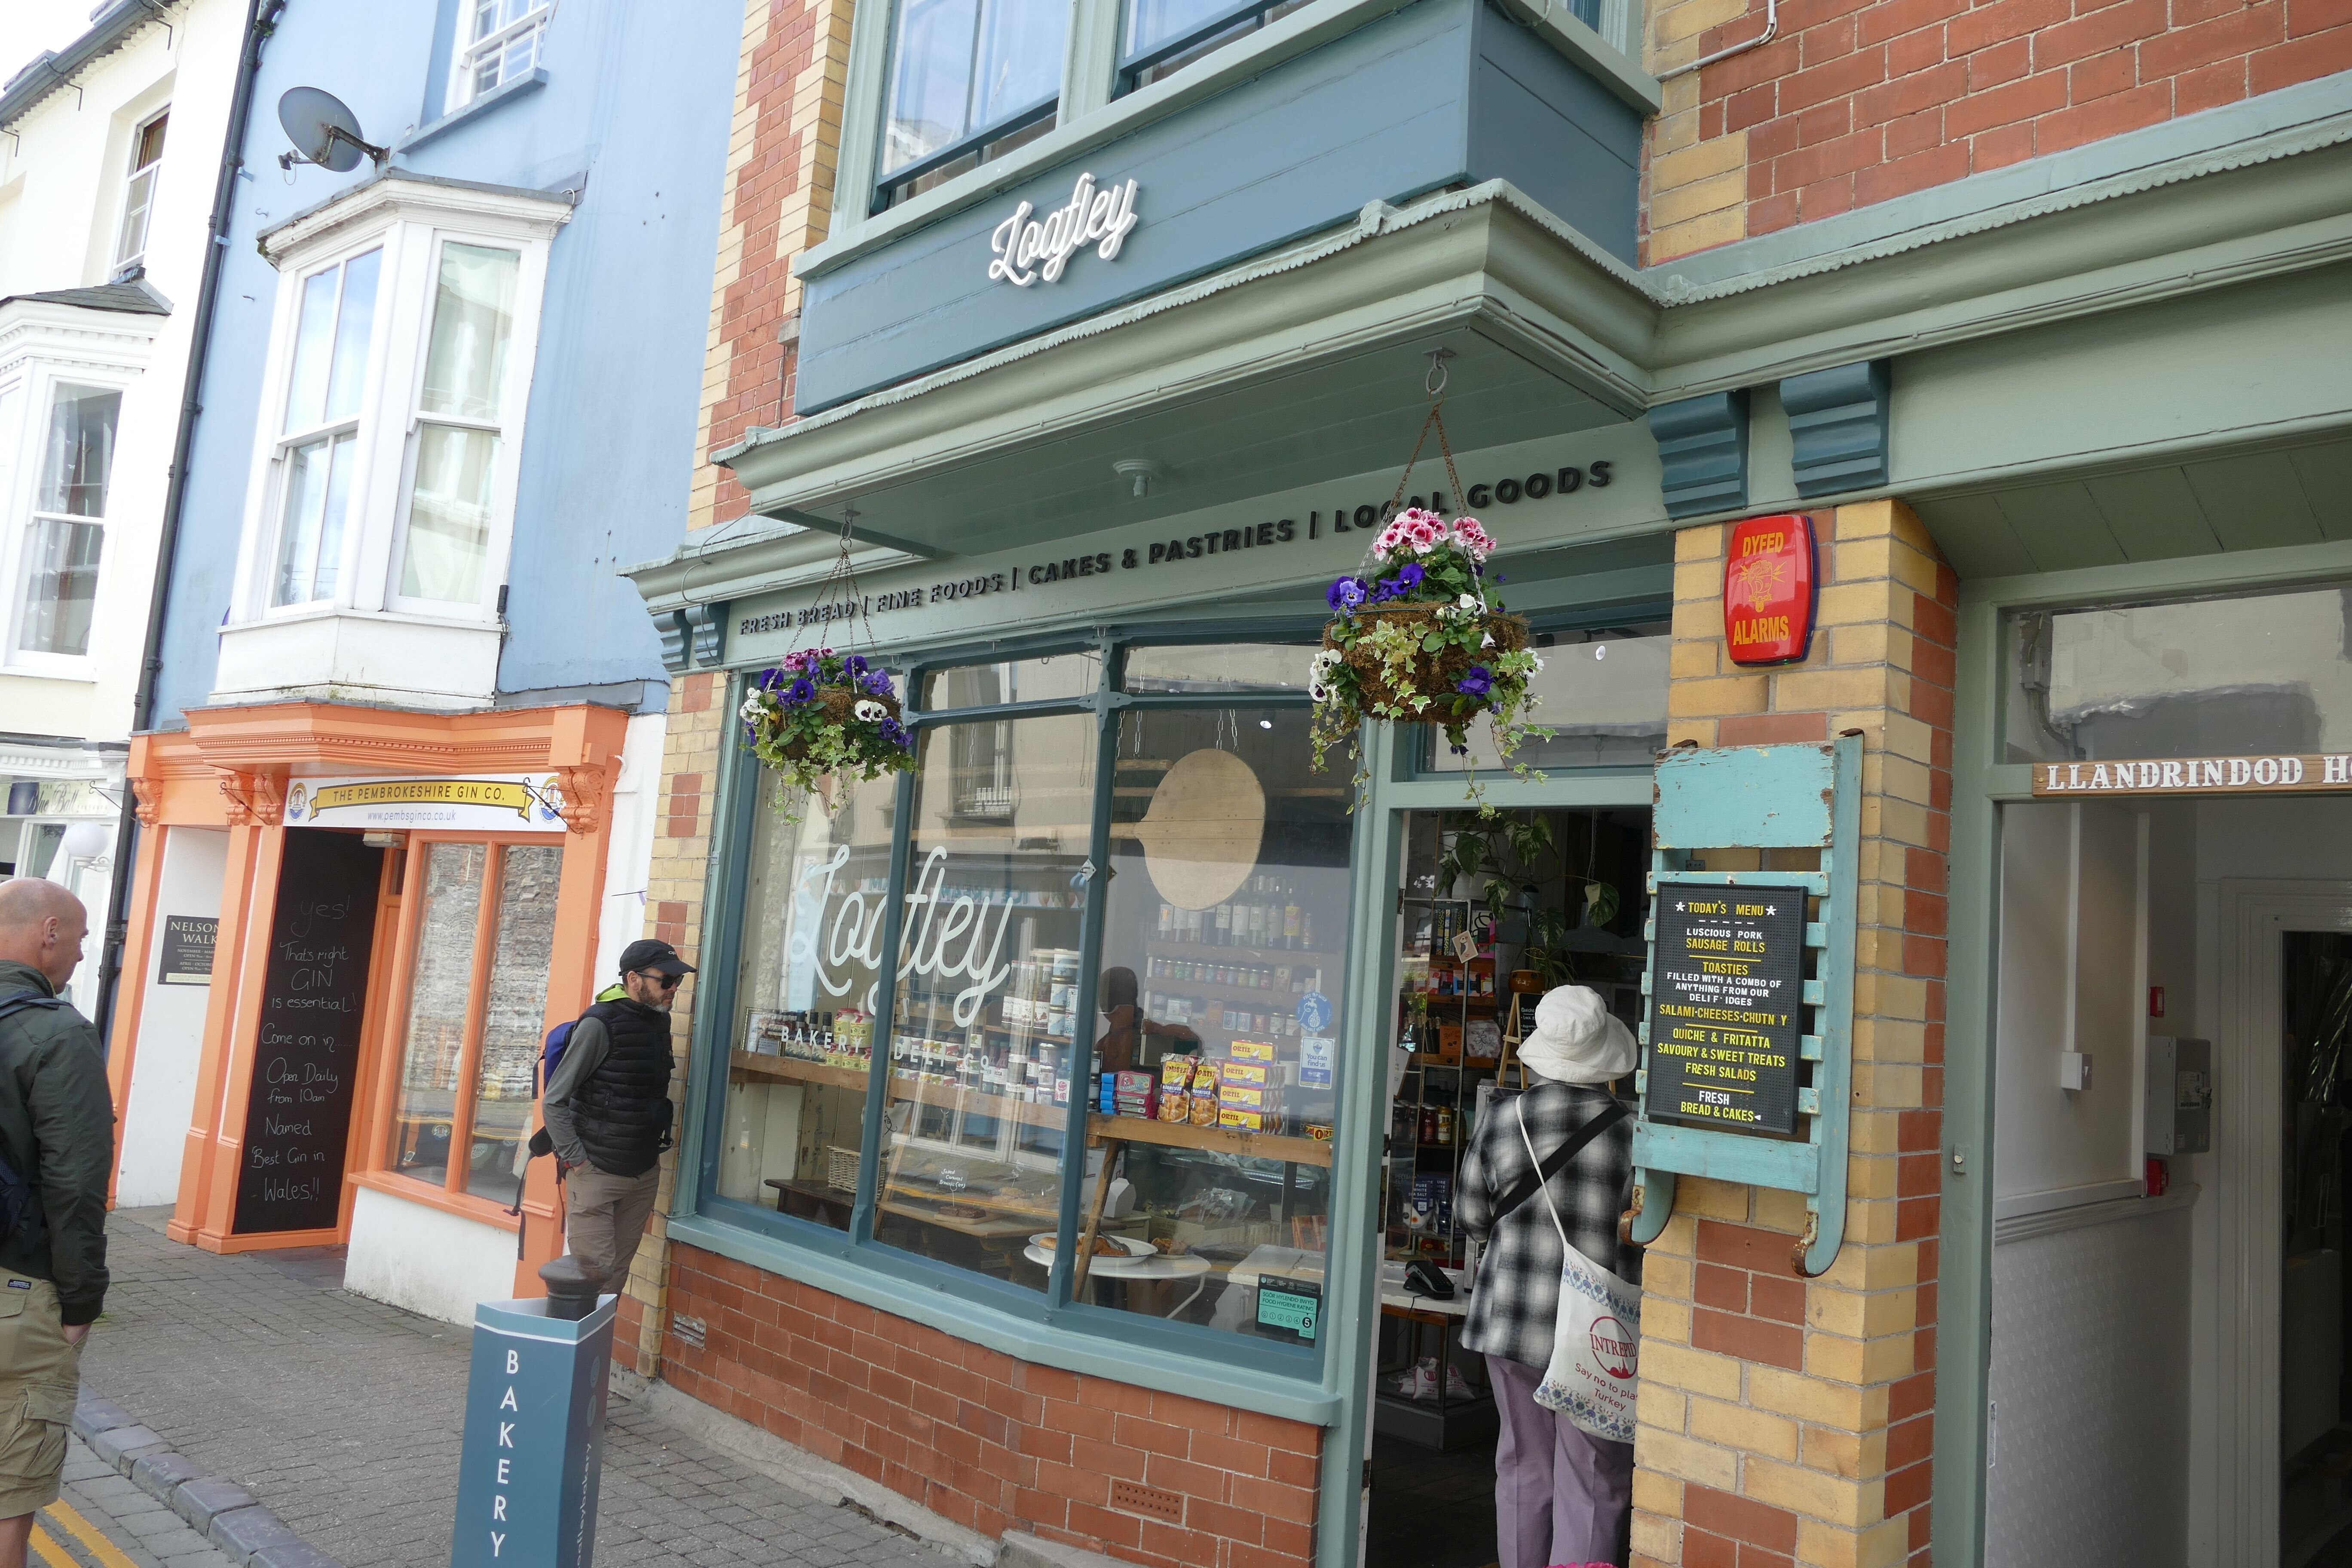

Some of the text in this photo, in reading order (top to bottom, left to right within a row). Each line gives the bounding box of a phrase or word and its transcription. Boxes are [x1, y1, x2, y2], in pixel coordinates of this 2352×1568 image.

[988, 172, 1138, 287] Loafley
[739, 611, 790, 635] FRESH
[796, 601, 855, 626] BREAD
[876, 588, 920, 612] FINE
[930, 573, 1001, 603] FOODS
[1028, 553, 1109, 585] CAKES
[1121, 548, 1135, 569] &
[1148, 519, 1292, 564] PASTRIES
[1334, 491, 1447, 533] LOCAL
[1467, 460, 1611, 509] GOODS
[1742, 531, 1785, 557] DYFED
[1733, 615, 1789, 646] ALARMS
[2046, 756, 2352, 790] LLANDRINDOD H
[28, 783, 80, 813] Blue Ball
[334, 789, 353, 802] THE
[358, 785, 452, 800] PEMBROKESHIRE
[457, 786, 478, 799] GIN
[368, 808, 456, 823] www.pembsginco.co.uk
[291, 894, 350, 937] yes!
[1688, 900, 1764, 916] TODAY'S MENU
[1686, 928, 1762, 939] LUSCIOUS PORK
[279, 941, 349, 968] That's right
[1686, 938, 1765, 953] SAUSAGE ROLLS
[291, 968, 333, 990] GIN
[1703, 962, 1749, 975] TOASTIES
[1667, 972, 1700, 982] FILLED
[1702, 974, 1724, 984] WITH
[1735, 977, 1766, 987] COMBO
[1769, 980, 1782, 988] OF
[1675, 983, 1769, 997] ANYTHING FROM OUR
[272, 994, 282, 1008] is
[1689, 993, 1710, 1002] DELI
[261, 1023, 292, 1044] Come
[299, 1036, 315, 1045] on
[1672, 1028, 1770, 1048] QUICHE & FRITATTA
[781, 1026, 862, 1053] BAKERY
[894, 1042, 945, 1067] DELI
[1657, 1042, 1785, 1067] SAVOURY & SWEET TREATS
[267, 1057, 338, 1093] Open Daily
[1165, 1066, 1187, 1074] ORTIZ
[1685, 1063, 1756, 1081] FRESH SALADS
[267, 1088, 325, 1103] from 10am
[1699, 1090, 1730, 1105] FRESH
[1681, 1101, 1754, 1122] BREAD & CAKES
[265, 1113, 312, 1137] Named
[287, 1147, 307, 1164] Gin
[313, 1150, 325, 1161] in
[1276, 1295, 1299, 1303] HYLENDID
[1277, 1300, 1296, 1308] HYGIENE
[1589, 1334, 1638, 1357] INTREPID
[1575, 1363, 1592, 1380] Say
[1593, 1375, 1606, 1387] no
[1609, 1382, 1618, 1393] to
[1595, 1388, 1626, 1412] Turkey
[491, 1349, 519, 1557] BAKERY
